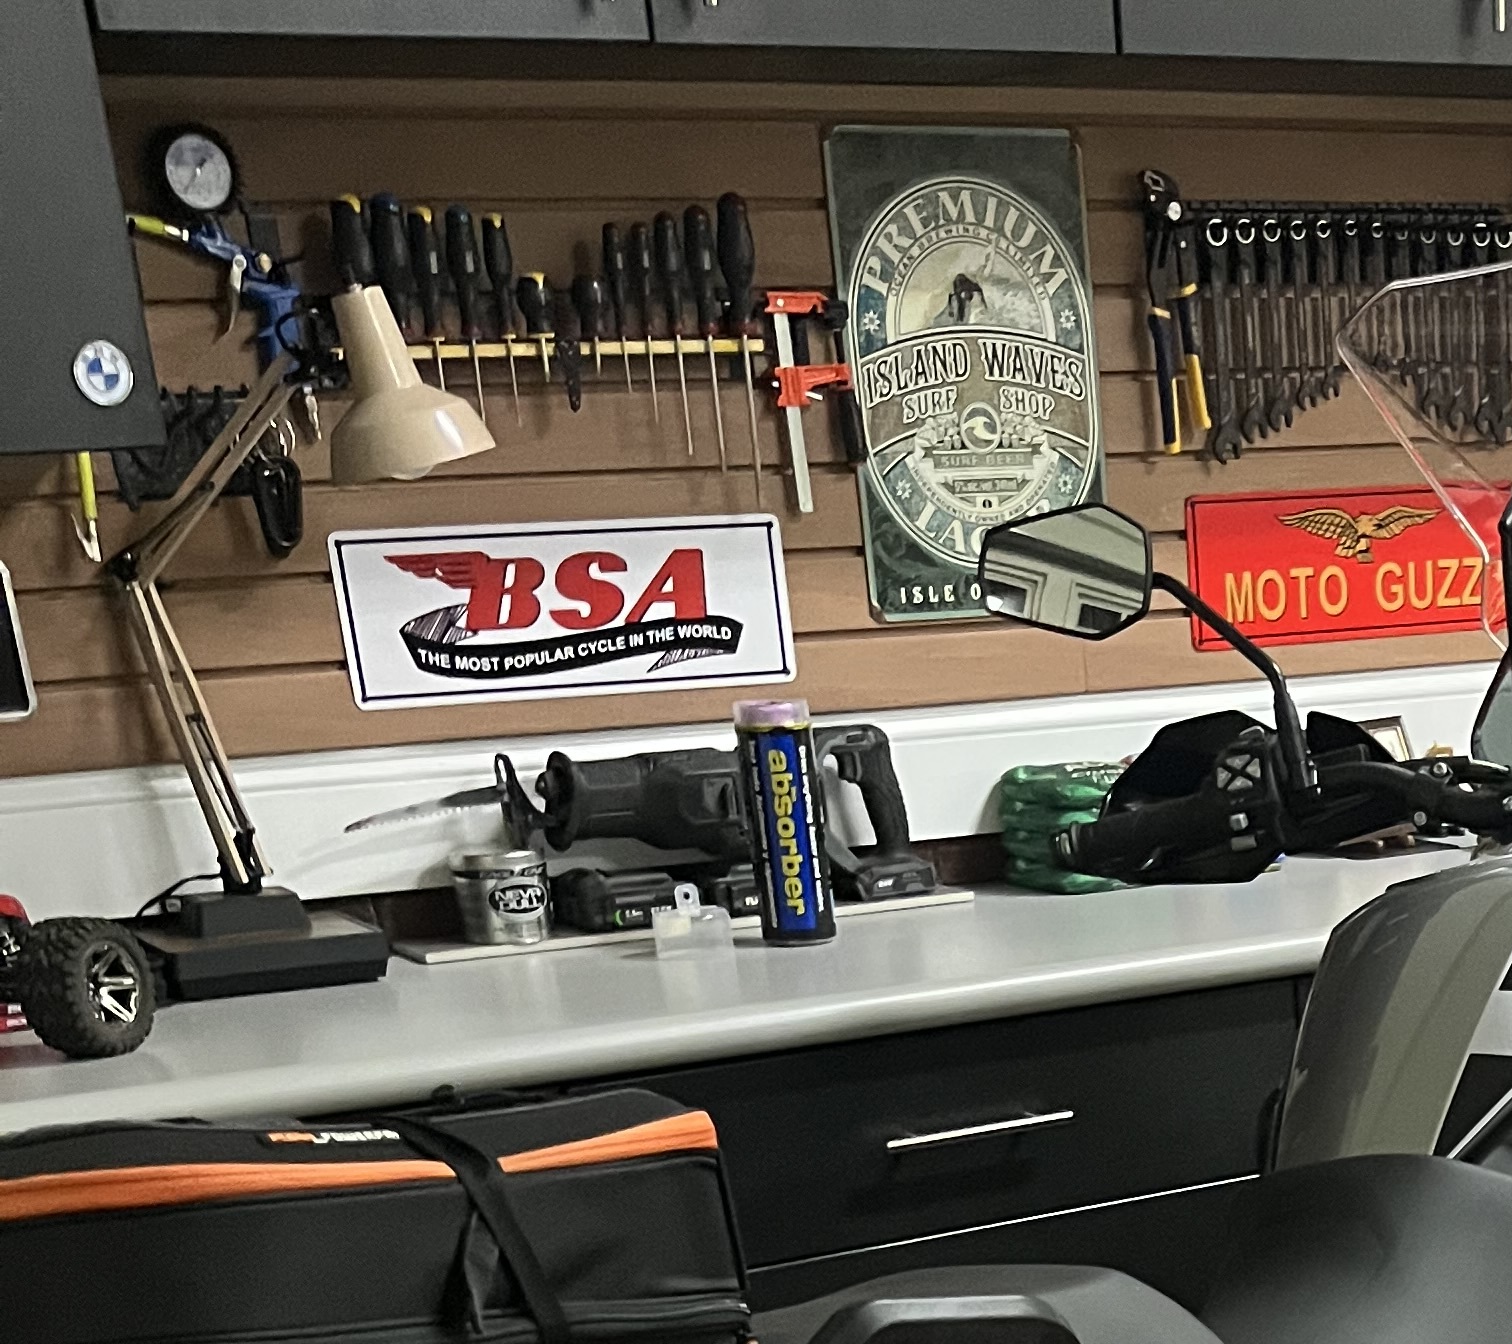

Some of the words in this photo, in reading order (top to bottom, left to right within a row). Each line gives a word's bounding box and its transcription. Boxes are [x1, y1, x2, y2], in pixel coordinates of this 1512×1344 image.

[861, 189, 1069, 297] PREMIUM
[862, 339, 970, 408] ISLAND
[977, 338, 1086, 401] WAVES
[902, 386, 957, 423] SURF
[999, 386, 1055, 420] SHOP
[941, 454, 978, 467] SURF
[465, 548, 707, 631] BSA
[900, 585, 955, 604] ISLE
[1224, 564, 1348, 624] MOTO
[1376, 556, 1484, 613] GUZZ
[418, 648, 451, 669] THE
[455, 652, 499, 671] MOST
[504, 645, 574, 671] POPULAR
[578, 635, 626, 657] CYCLE
[629, 632, 644, 649] IN
[645, 629, 676, 645] THE
[678, 624, 733, 642] WORLD
[768, 749, 805, 916] absorber
